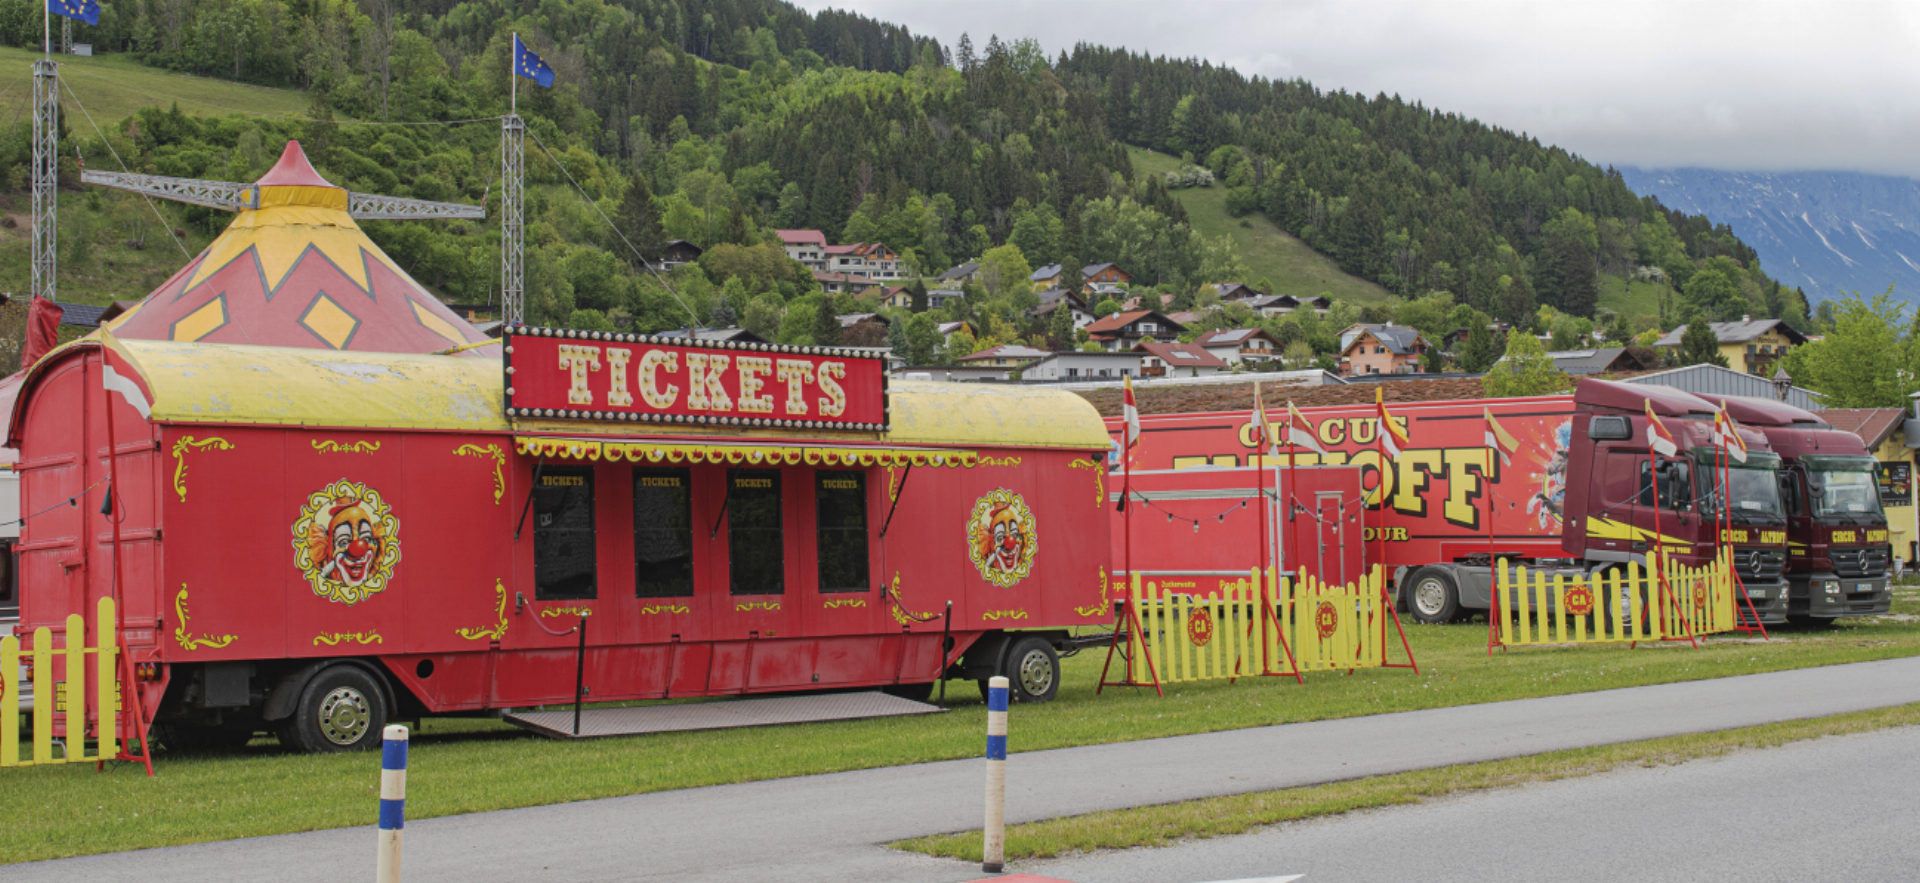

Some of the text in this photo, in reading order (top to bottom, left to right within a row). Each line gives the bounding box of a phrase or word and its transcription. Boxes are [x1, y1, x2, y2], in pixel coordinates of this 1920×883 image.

[558, 343, 847, 418] TICKETS
[542, 475, 584, 486] TICKETS
[641, 476, 681, 487] TICKETS
[735, 478, 772, 488] TICKETS
[822, 479, 857, 489] TICKETS
[1363, 526, 1410, 541] OUR
[1571, 594, 1587, 606] CA
[1194, 619, 1207, 634] CA
